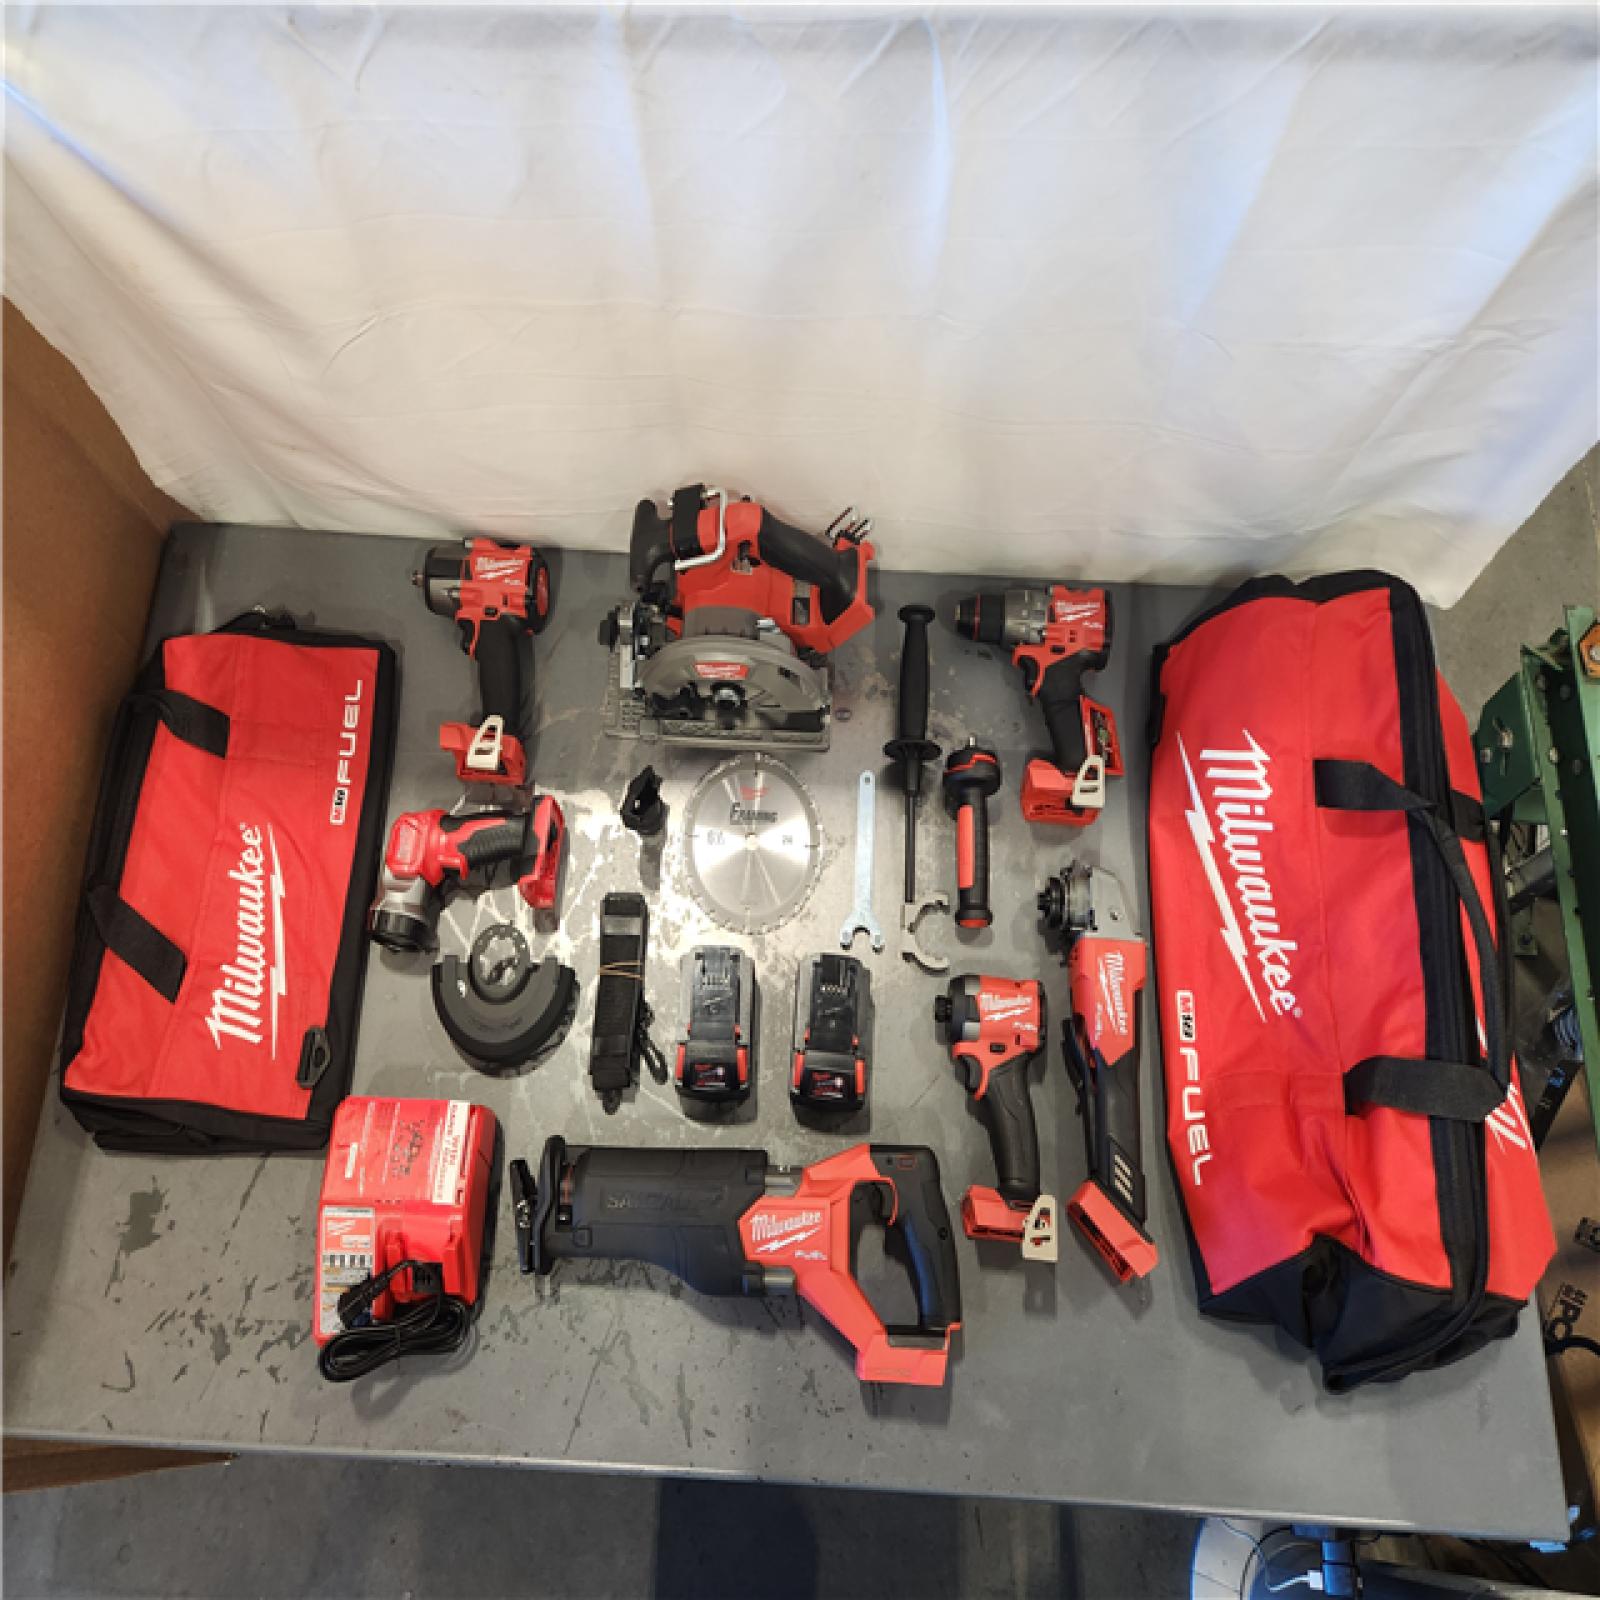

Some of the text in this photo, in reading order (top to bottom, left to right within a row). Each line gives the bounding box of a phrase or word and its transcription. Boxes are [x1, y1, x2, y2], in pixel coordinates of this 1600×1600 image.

[337, 679, 363, 785] FUEL
[205, 826, 265, 1050] Milwaukee
[1199, 729, 1298, 1016] Milwaukee
[1179, 1047, 1212, 1186] FUEL
